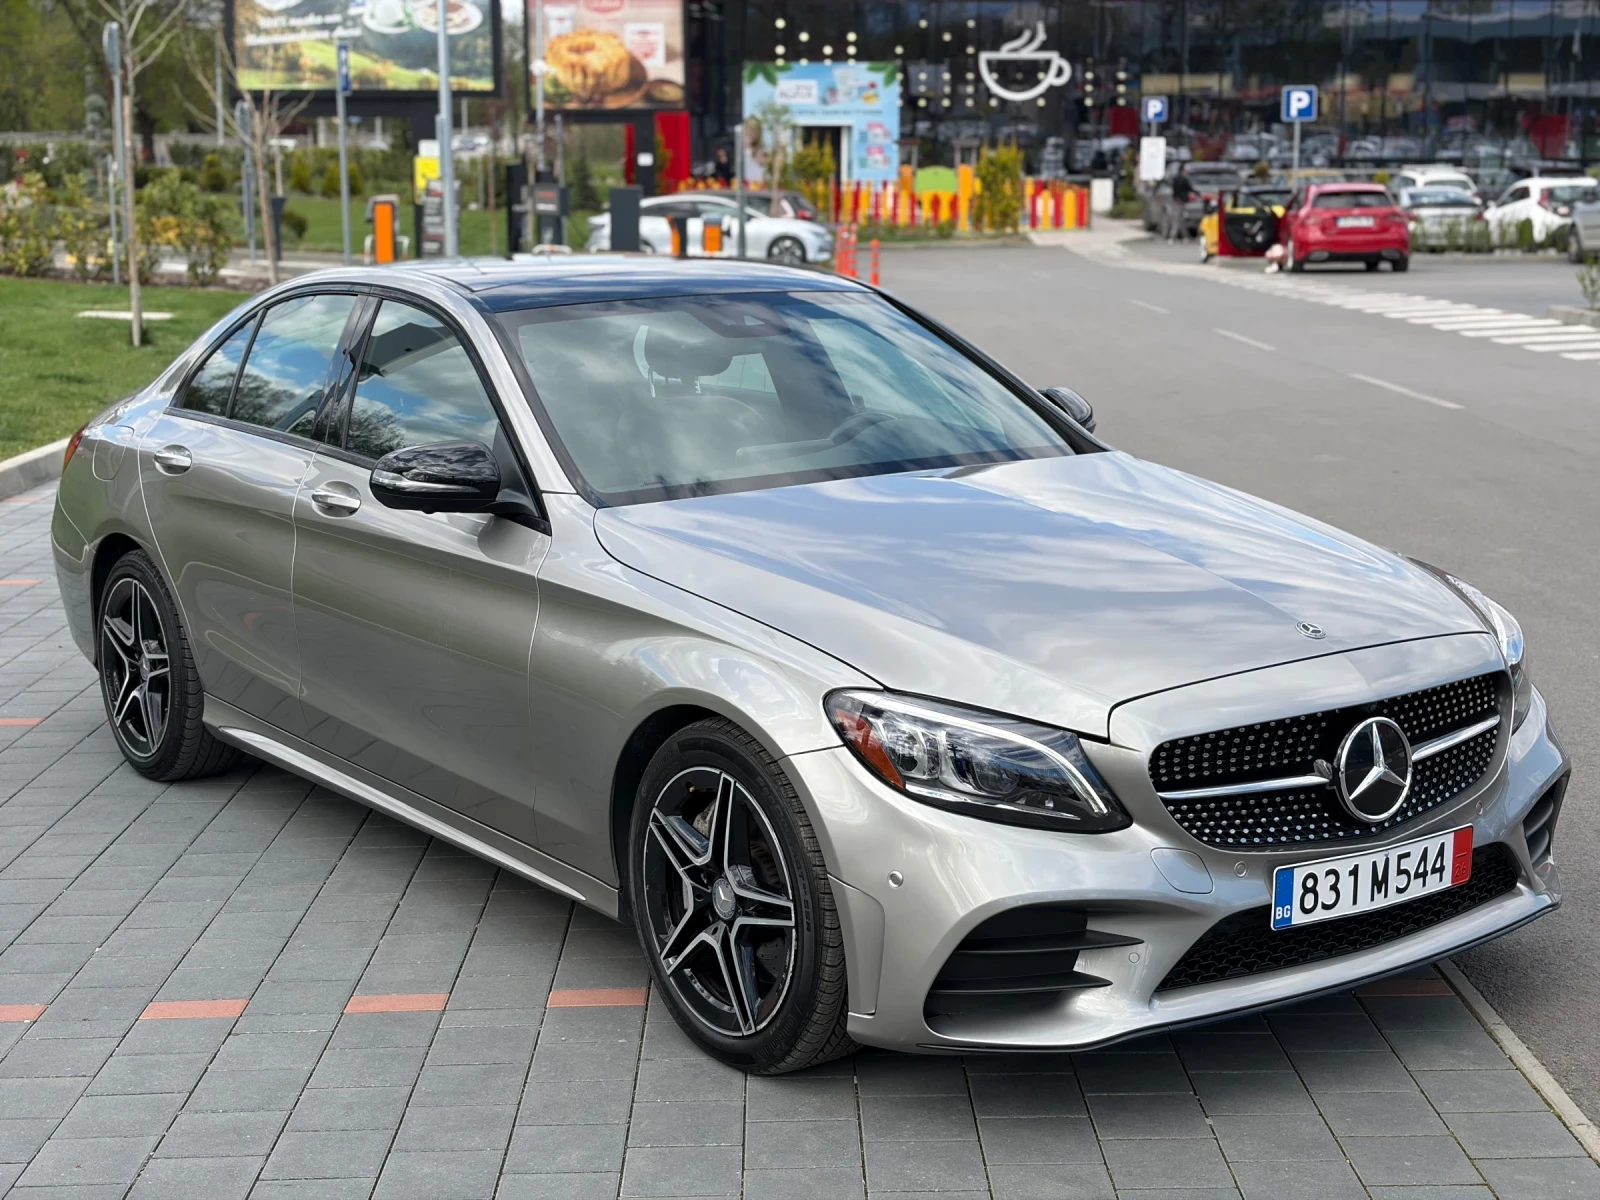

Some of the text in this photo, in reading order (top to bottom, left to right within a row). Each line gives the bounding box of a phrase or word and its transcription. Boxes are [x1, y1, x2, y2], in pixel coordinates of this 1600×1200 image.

[1147, 99, 1163, 119] P
[1290, 91, 1311, 118] P
[1455, 863, 1467, 878] 26
[1275, 905, 1291, 920] BG
